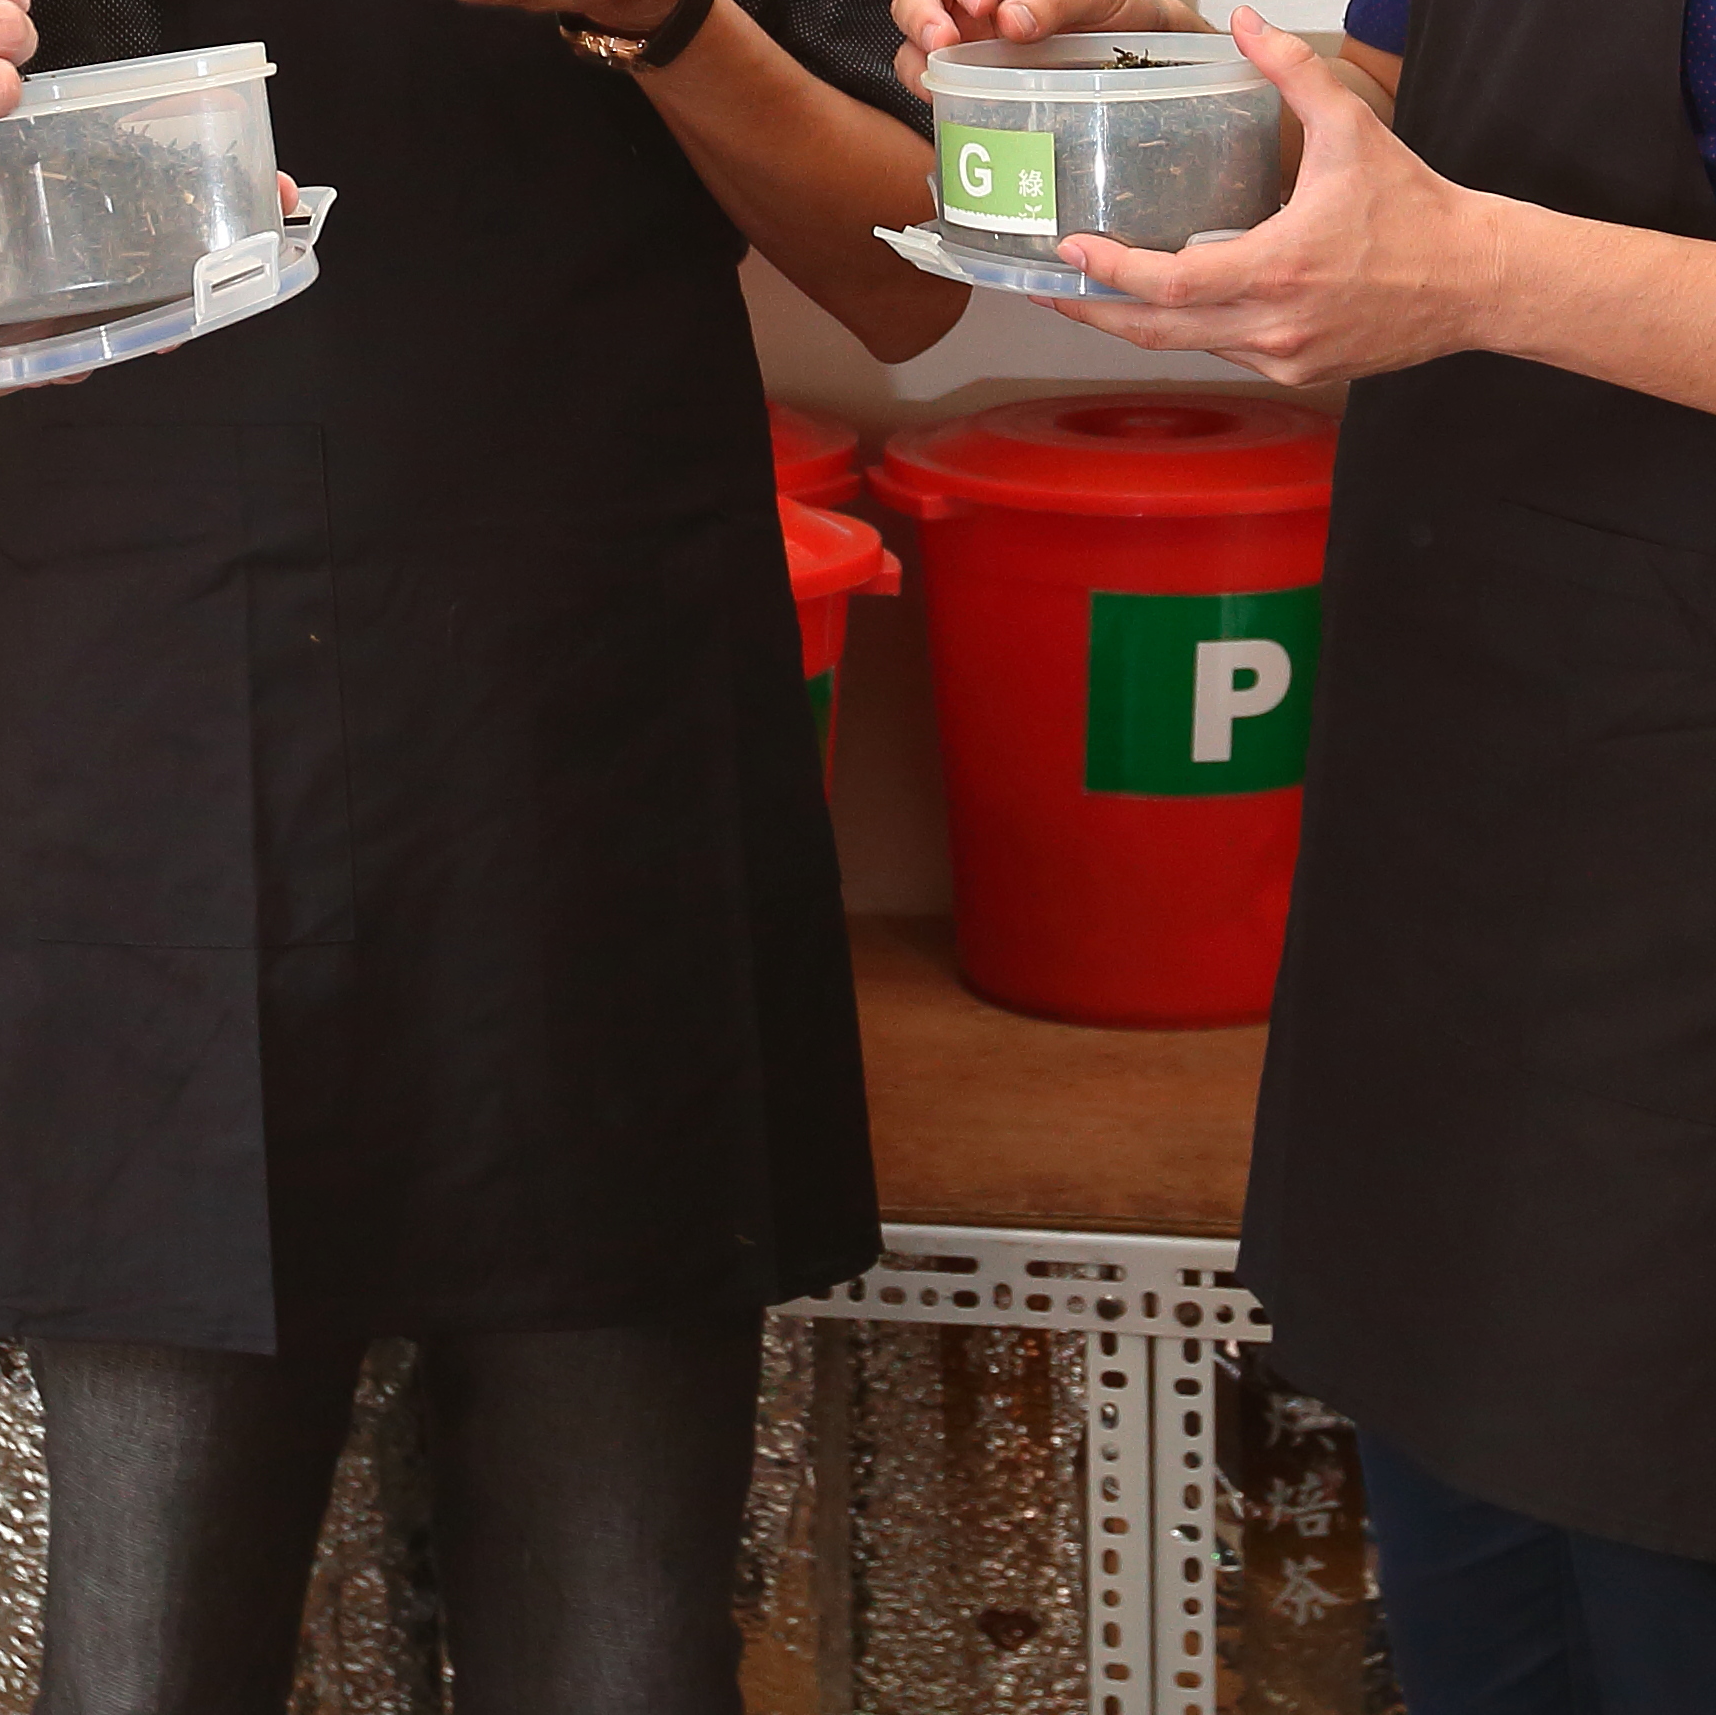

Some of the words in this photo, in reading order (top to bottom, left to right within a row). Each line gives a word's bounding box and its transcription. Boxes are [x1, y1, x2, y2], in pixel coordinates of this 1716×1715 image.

[958, 142, 993, 199] G
[1017, 168, 1044, 198] 綠
[1191, 639, 1293, 764] P
